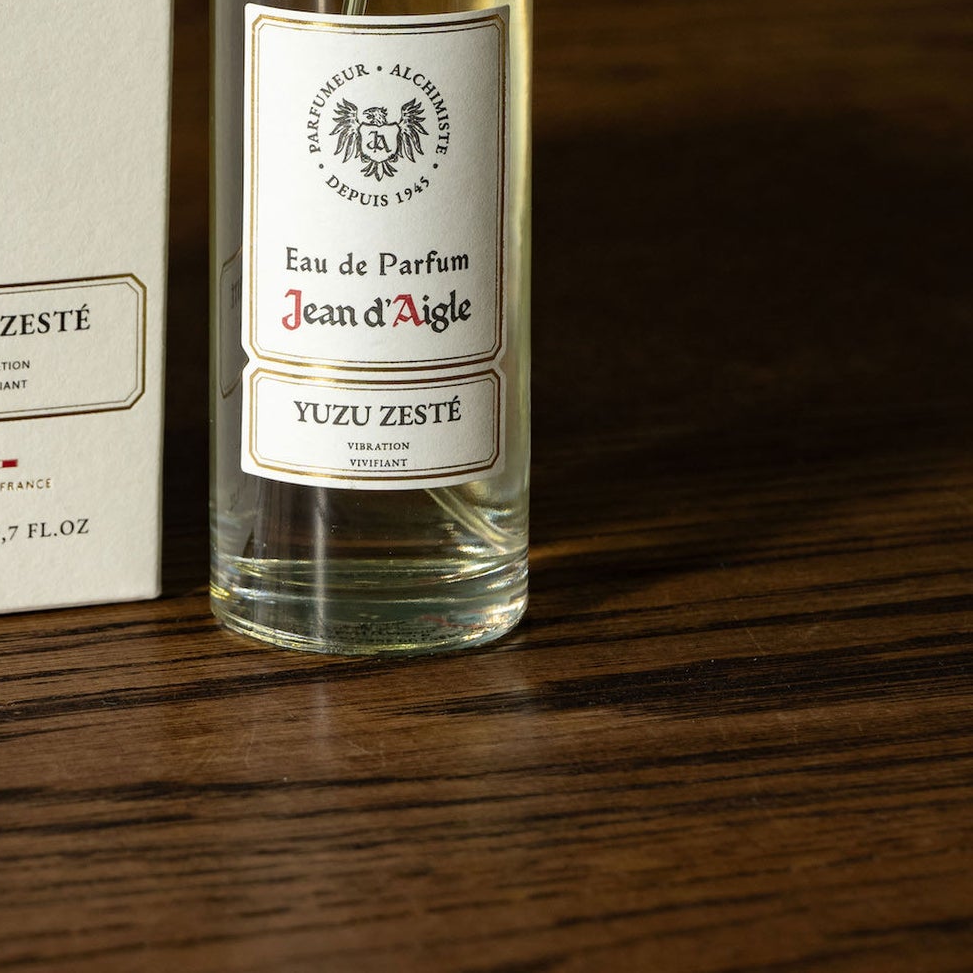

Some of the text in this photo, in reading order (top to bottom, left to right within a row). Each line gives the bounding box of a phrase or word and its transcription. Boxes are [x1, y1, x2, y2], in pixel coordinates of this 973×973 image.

[307, 63, 451, 156] PARFUMEUR ALCHIMISTE
[325, 174, 430, 207] DEPUIS 1945
[286, 246, 469, 276] Eau de Parfum
[0, 303, 91, 337] ZESTÉ
[281, 288, 358, 331] Jean
[293, 395, 462, 426] YUZU ZESTÉ
[347, 441, 410, 451] VIBRATION
[349, 457, 408, 468] VIVIFIANT
[0, 478, 53, 493] FRANCE
[27, 518, 90, 539] FL.OZ
